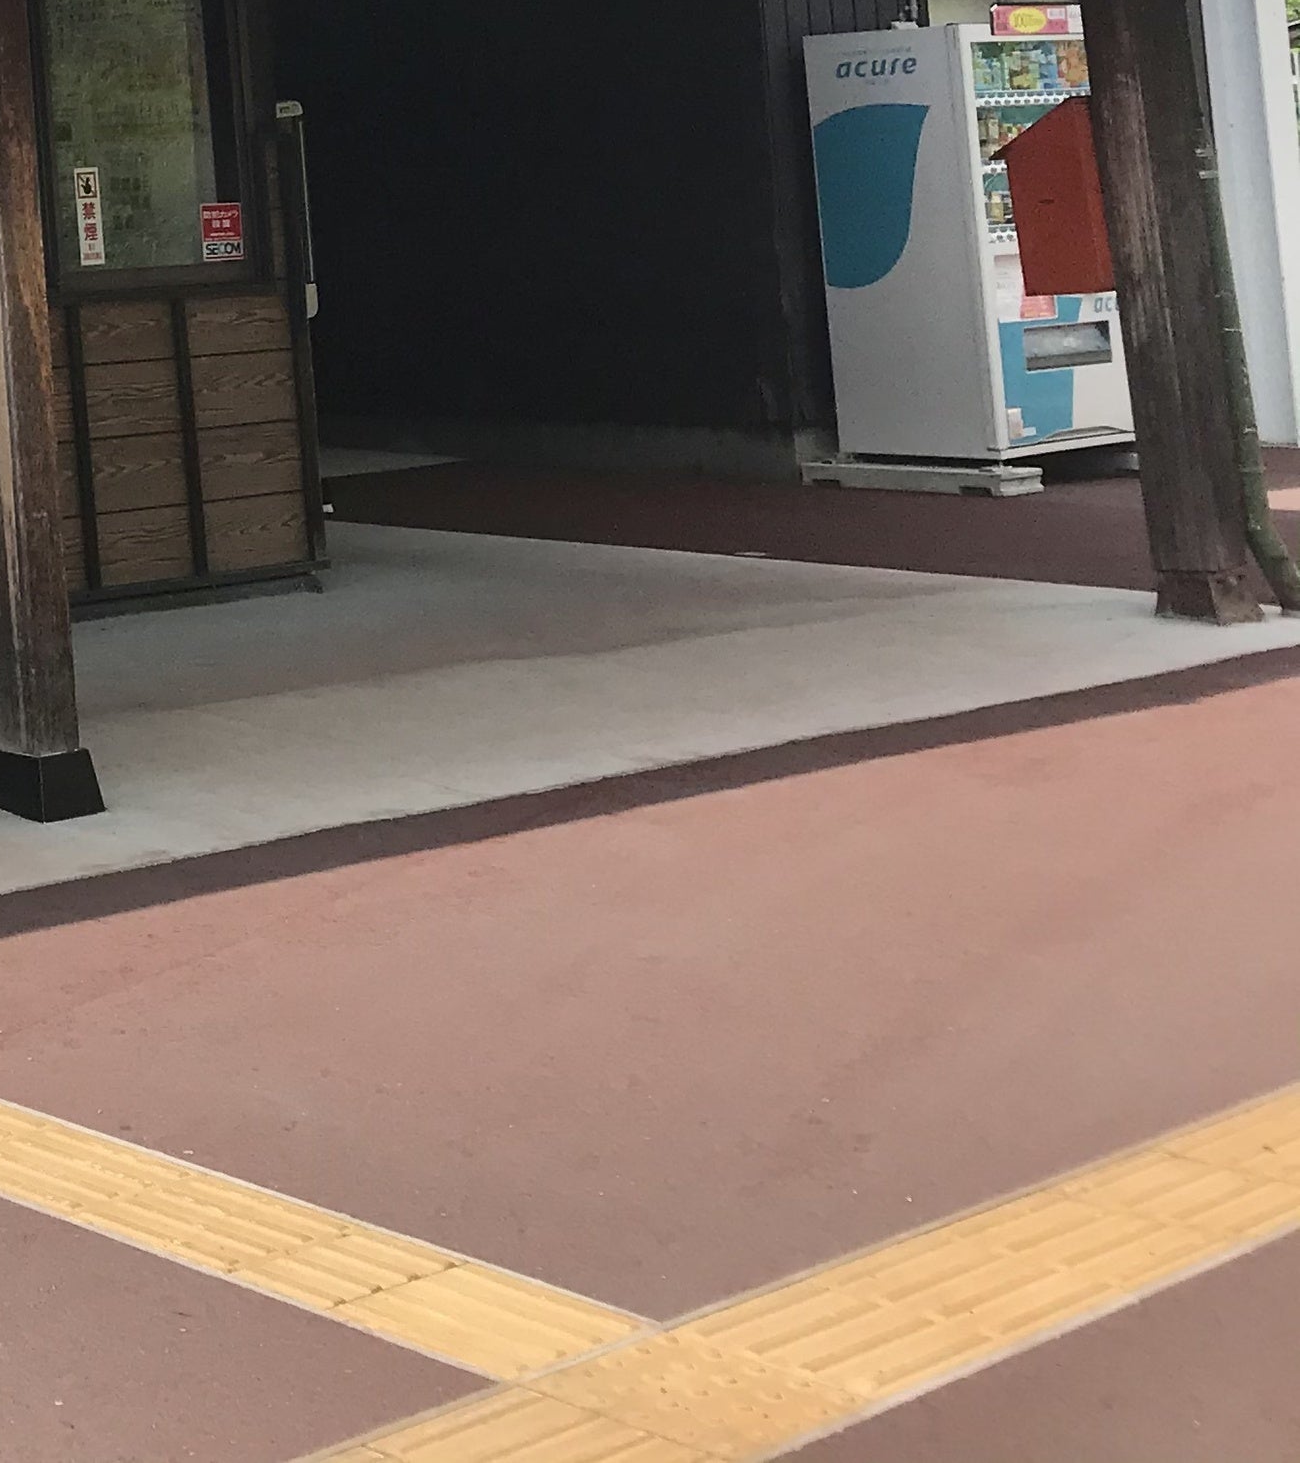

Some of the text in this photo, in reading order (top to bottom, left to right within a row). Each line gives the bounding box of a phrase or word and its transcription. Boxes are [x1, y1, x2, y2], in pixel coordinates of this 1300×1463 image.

[835, 57, 918, 79] acure
[82, 202, 99, 241] 禁煙
[206, 242, 241, 255] SECOM
